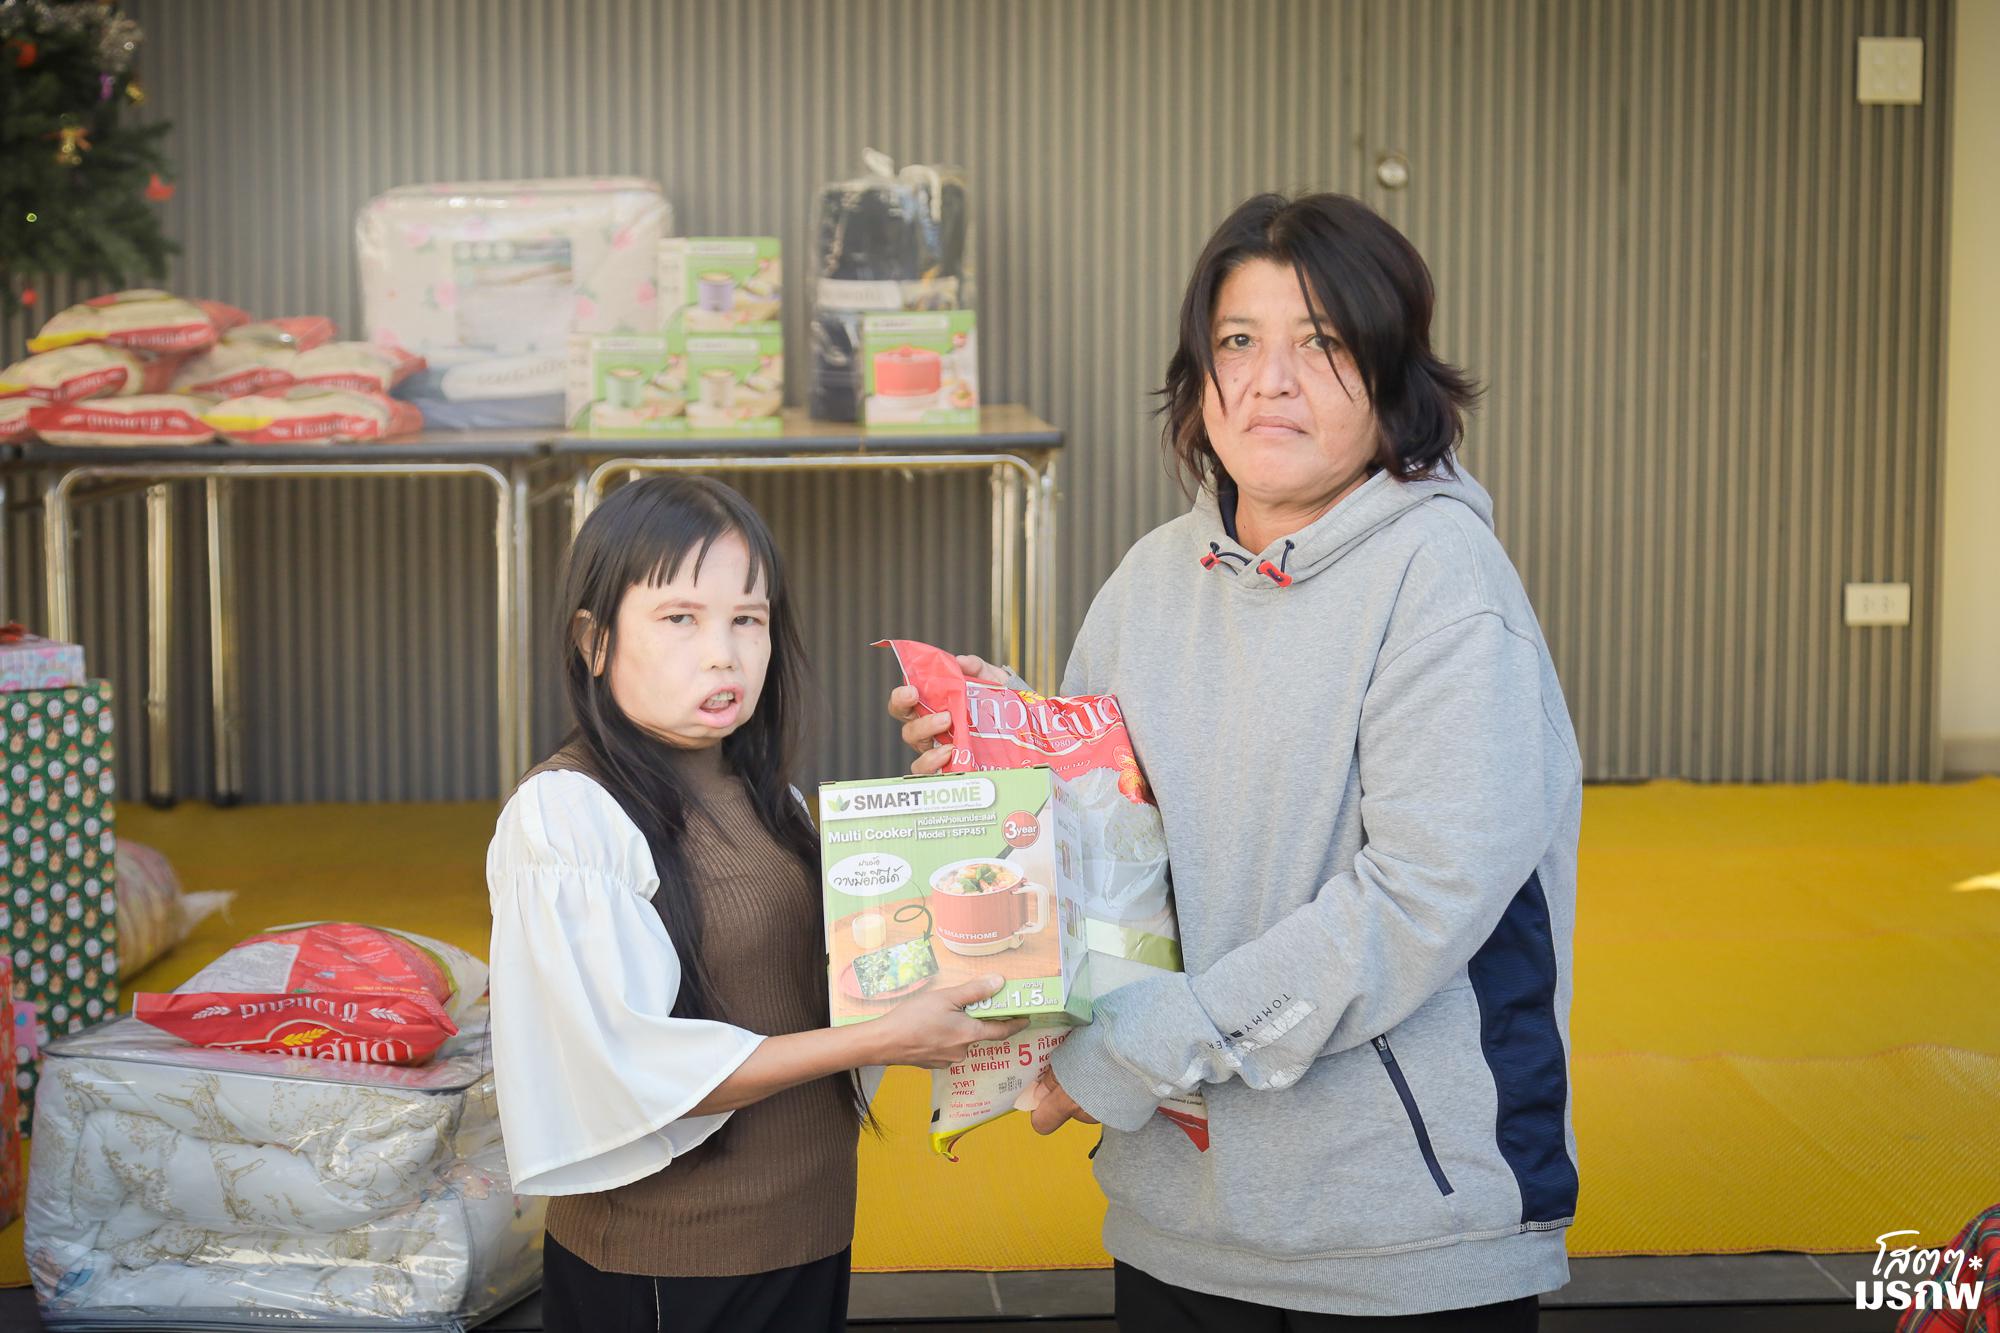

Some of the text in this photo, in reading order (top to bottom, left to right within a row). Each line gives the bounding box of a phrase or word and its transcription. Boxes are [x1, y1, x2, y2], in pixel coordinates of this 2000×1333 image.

[1028, 735, 1071, 750] Since 1980
[854, 786, 981, 811] SMARTHOME
[828, 827, 913, 844] Multi Cooker
[918, 831, 945, 840] Model
[952, 827, 986, 837] SFP451
[943, 929, 998, 940] SMARTHOME
[1011, 989, 1044, 1007] 1.5
[1245, 993, 1291, 1033] TOMMY
[1018, 1043, 1033, 1067] 5
[950, 1065, 965, 1075] NET
[971, 1060, 1011, 1073] WEIGHT
[952, 1079, 975, 1089] ราคา
